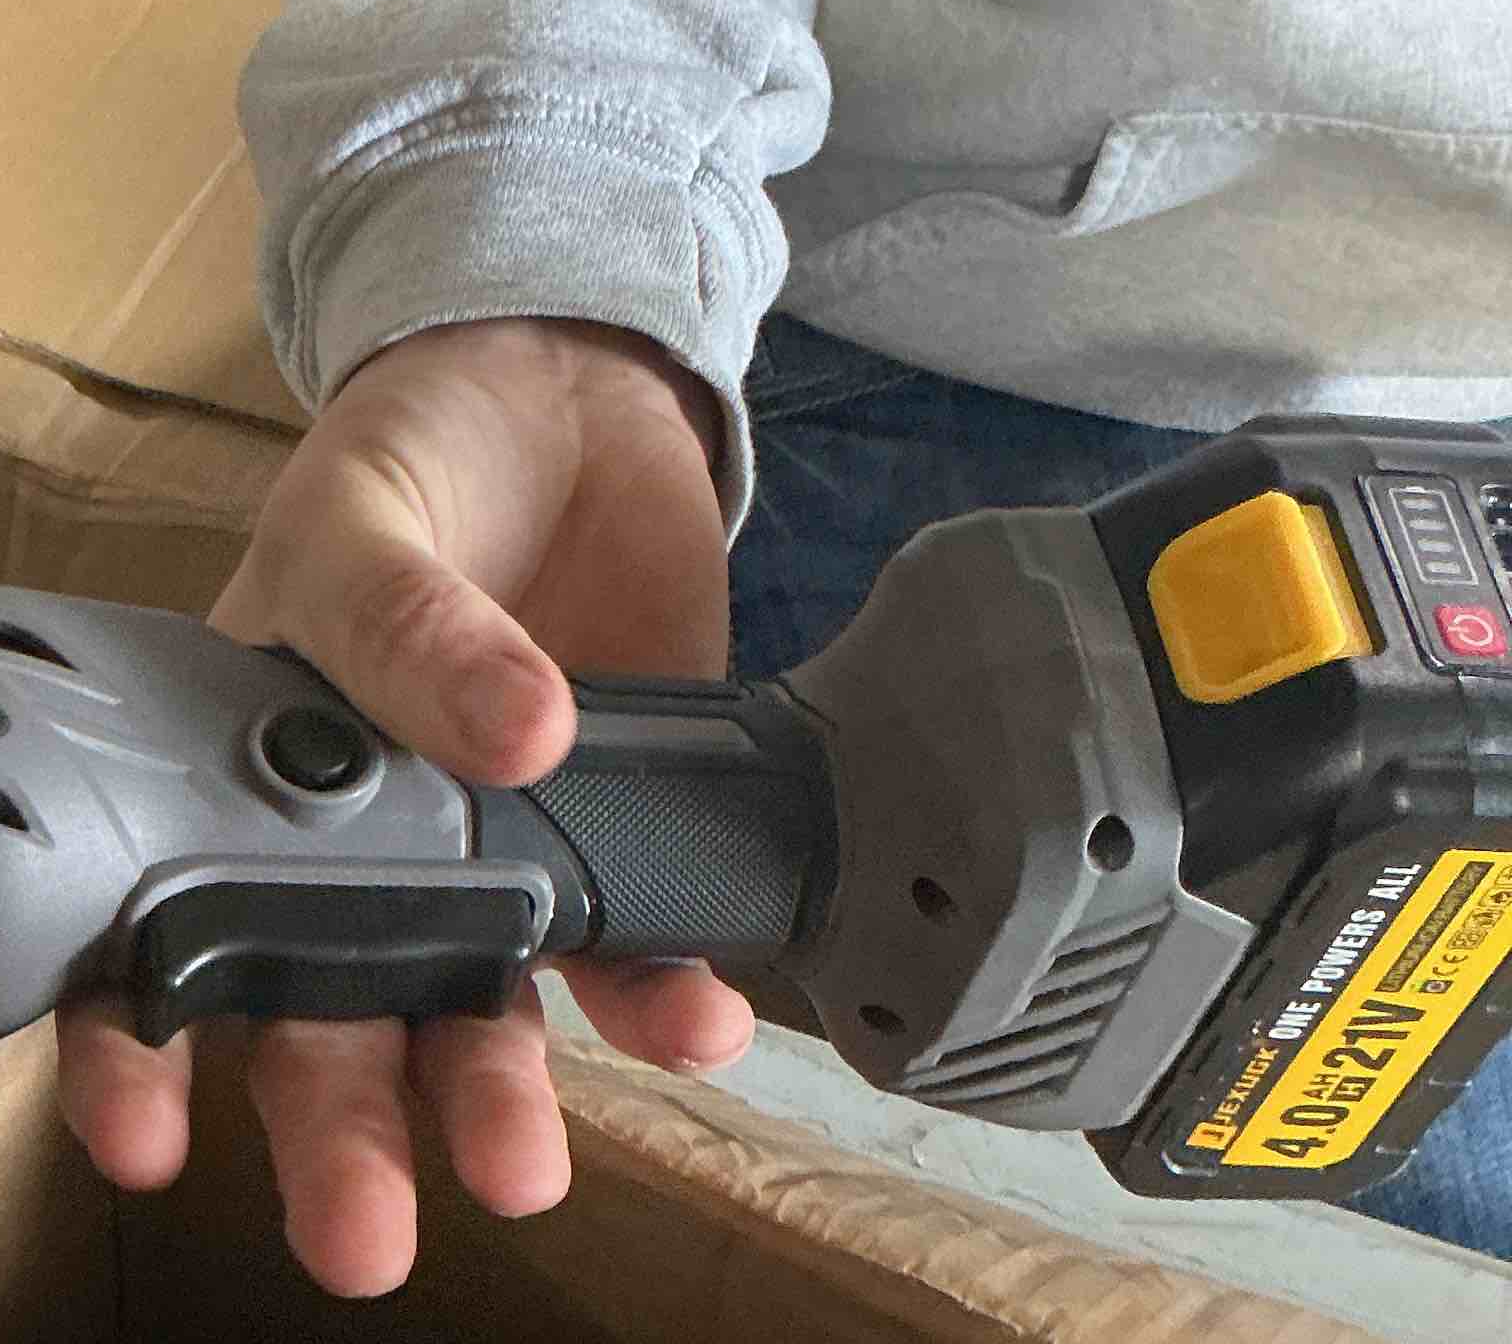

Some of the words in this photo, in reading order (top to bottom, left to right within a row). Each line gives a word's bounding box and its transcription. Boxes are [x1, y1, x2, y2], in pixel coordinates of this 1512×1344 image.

[1268, 1000, 1324, 1041] ONE
[1300, 908, 1387, 994] POWERS
[1367, 862, 1423, 901] ALL
[1322, 999, 1427, 1072] 21V
